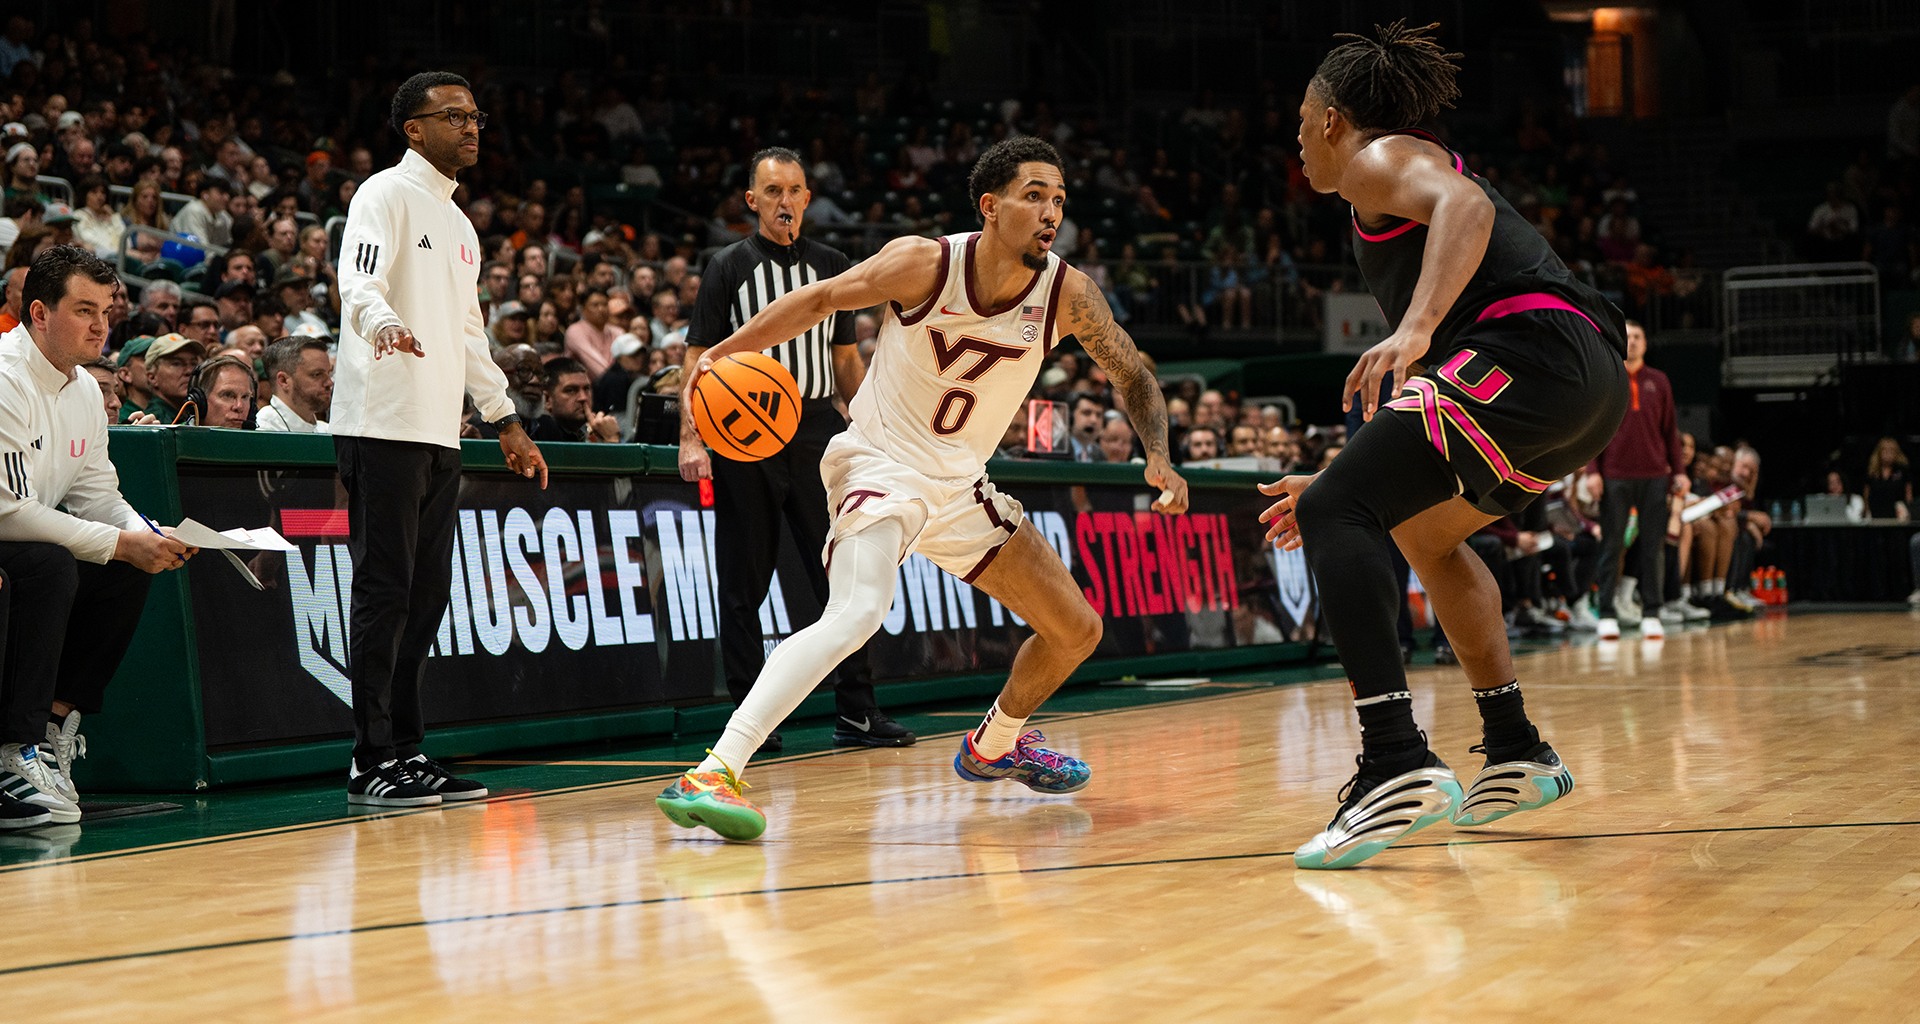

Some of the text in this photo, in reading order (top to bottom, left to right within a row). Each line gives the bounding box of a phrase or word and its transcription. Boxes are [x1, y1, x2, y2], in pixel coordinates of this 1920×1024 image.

[460, 244, 474, 265] U
[926, 325, 1032, 383] VT
[1437, 349, 1514, 404] U
[722, 409, 762, 446] U
[930, 387, 978, 437] 0
[70, 439, 86, 458] U
[1075, 511, 1239, 618] STRENGTH
